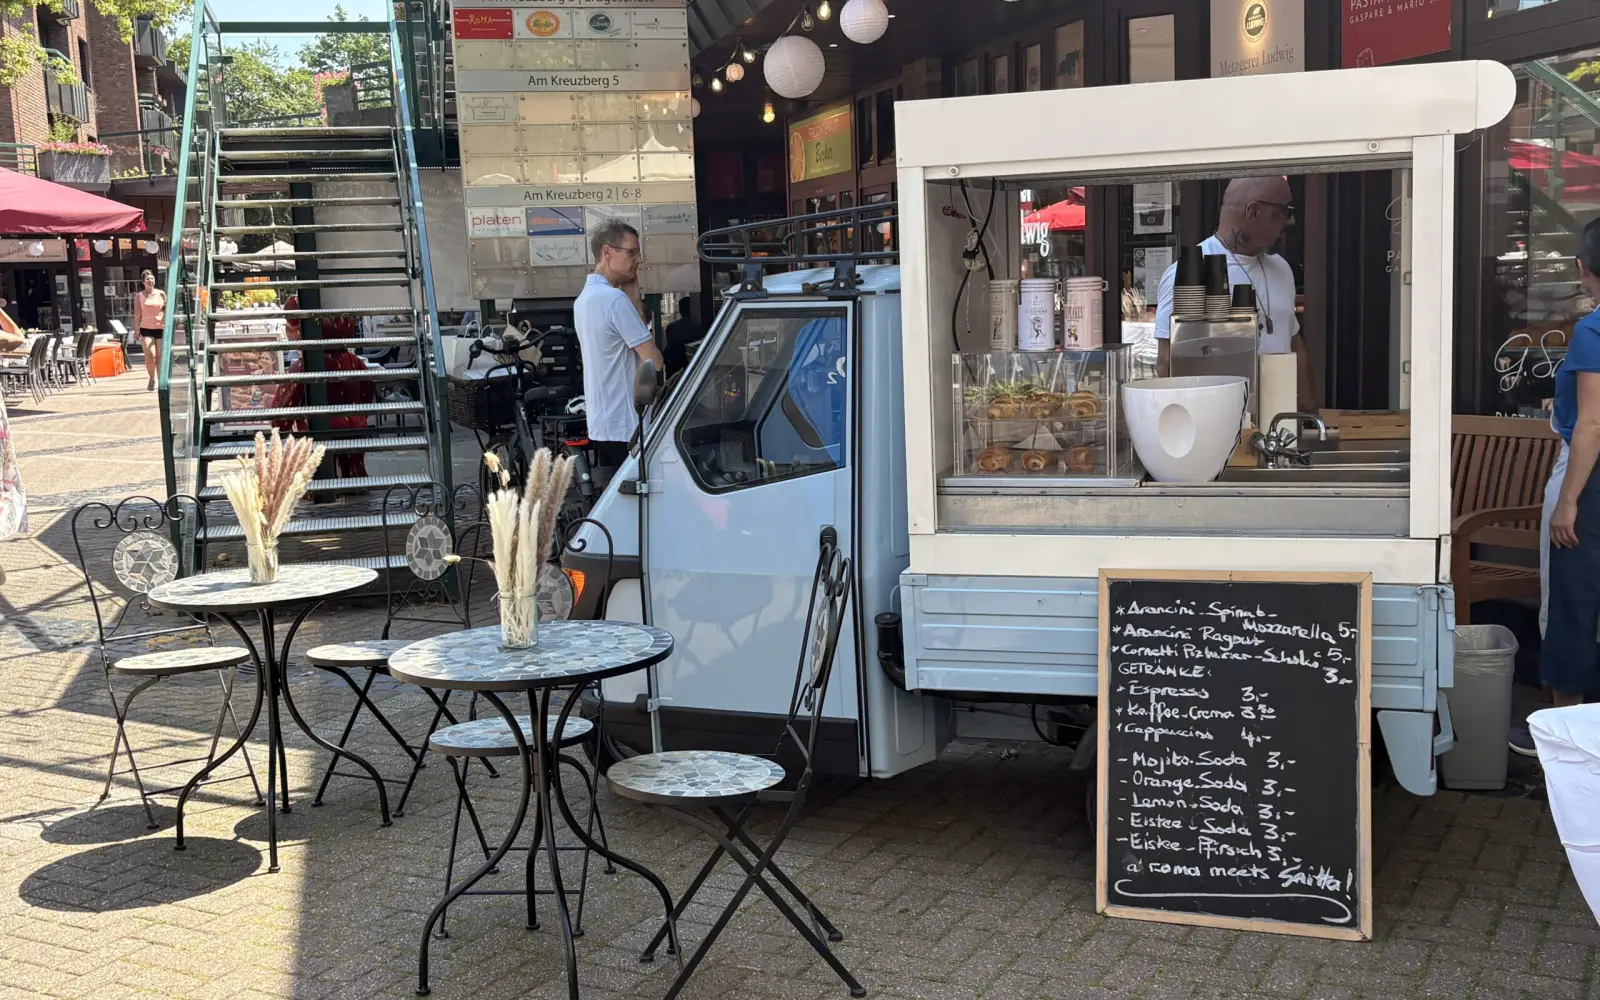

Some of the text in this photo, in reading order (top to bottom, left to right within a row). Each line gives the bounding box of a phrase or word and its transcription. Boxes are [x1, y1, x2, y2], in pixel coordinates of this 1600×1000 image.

[1349, 0, 1424, 24] GASPARE & MARIO
[1220, 43, 1295, 76] Metzgerei Ludwig
[528, 75, 619, 88] Am Kreuzberg 5
[524, 190, 543, 201] Am
[546, 188, 603, 202] Kreuzberg
[606, 188, 613, 199] 2
[622, 188, 642, 199] 6-8
[471, 214, 522, 228] platen
[1123, 624, 1192, 640] Arancini
[1198, 627, 1265, 651] Ragout
[1242, 619, 1337, 644] Mozzarella
[1120, 643, 1178, 657] Cornetti
[1128, 680, 1209, 703] Espresso
[1124, 722, 1214, 743] Cappuccino
[1149, 862, 1201, 877] roma
[1210, 866, 1271, 879] meets
